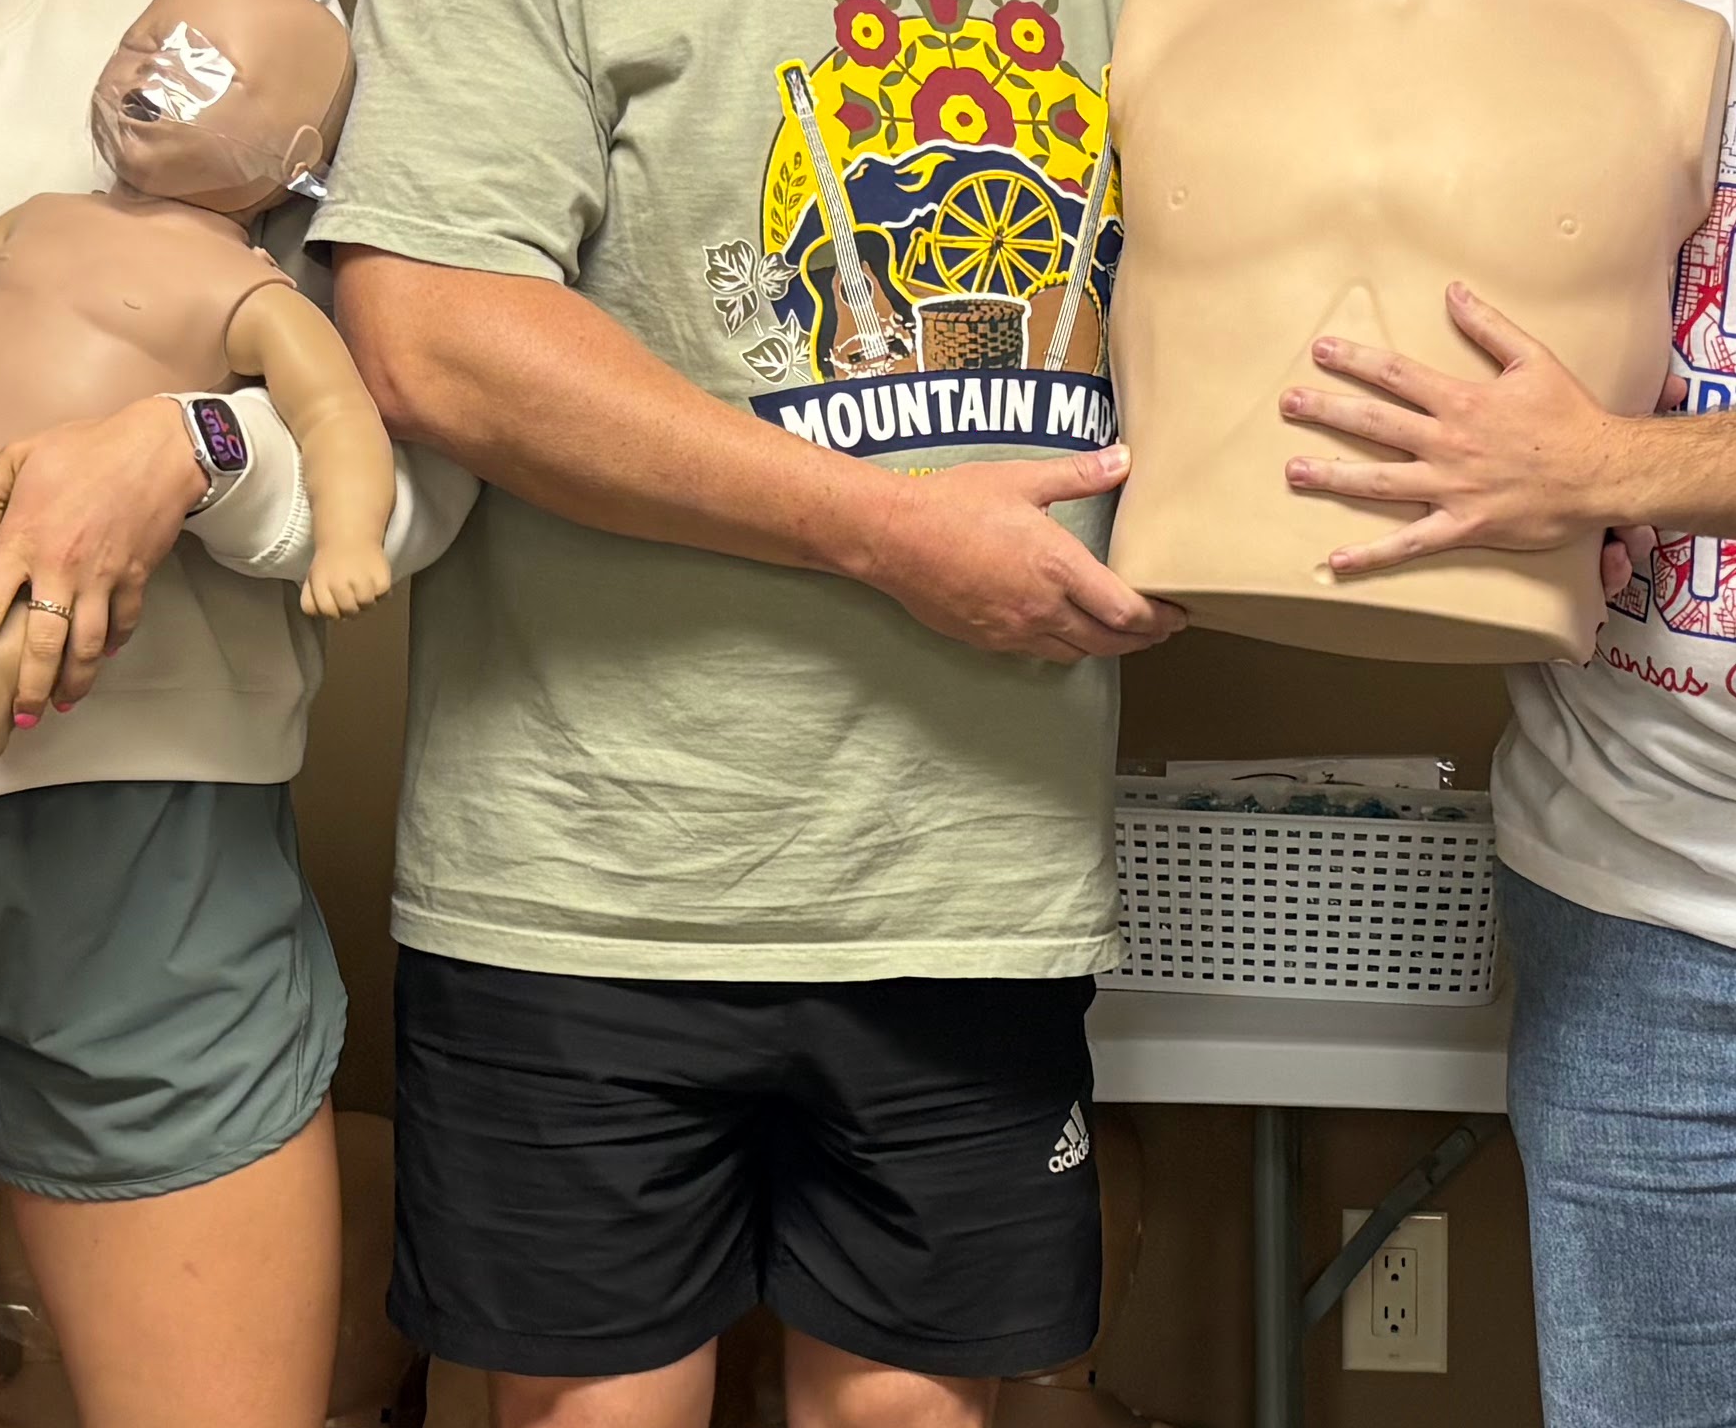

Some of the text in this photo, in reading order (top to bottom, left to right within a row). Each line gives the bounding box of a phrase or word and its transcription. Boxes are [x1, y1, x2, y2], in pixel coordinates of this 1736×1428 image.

[779, 378, 1118, 449] MOUNTAIN MAD
[1595, 628, 1708, 696] ansas
